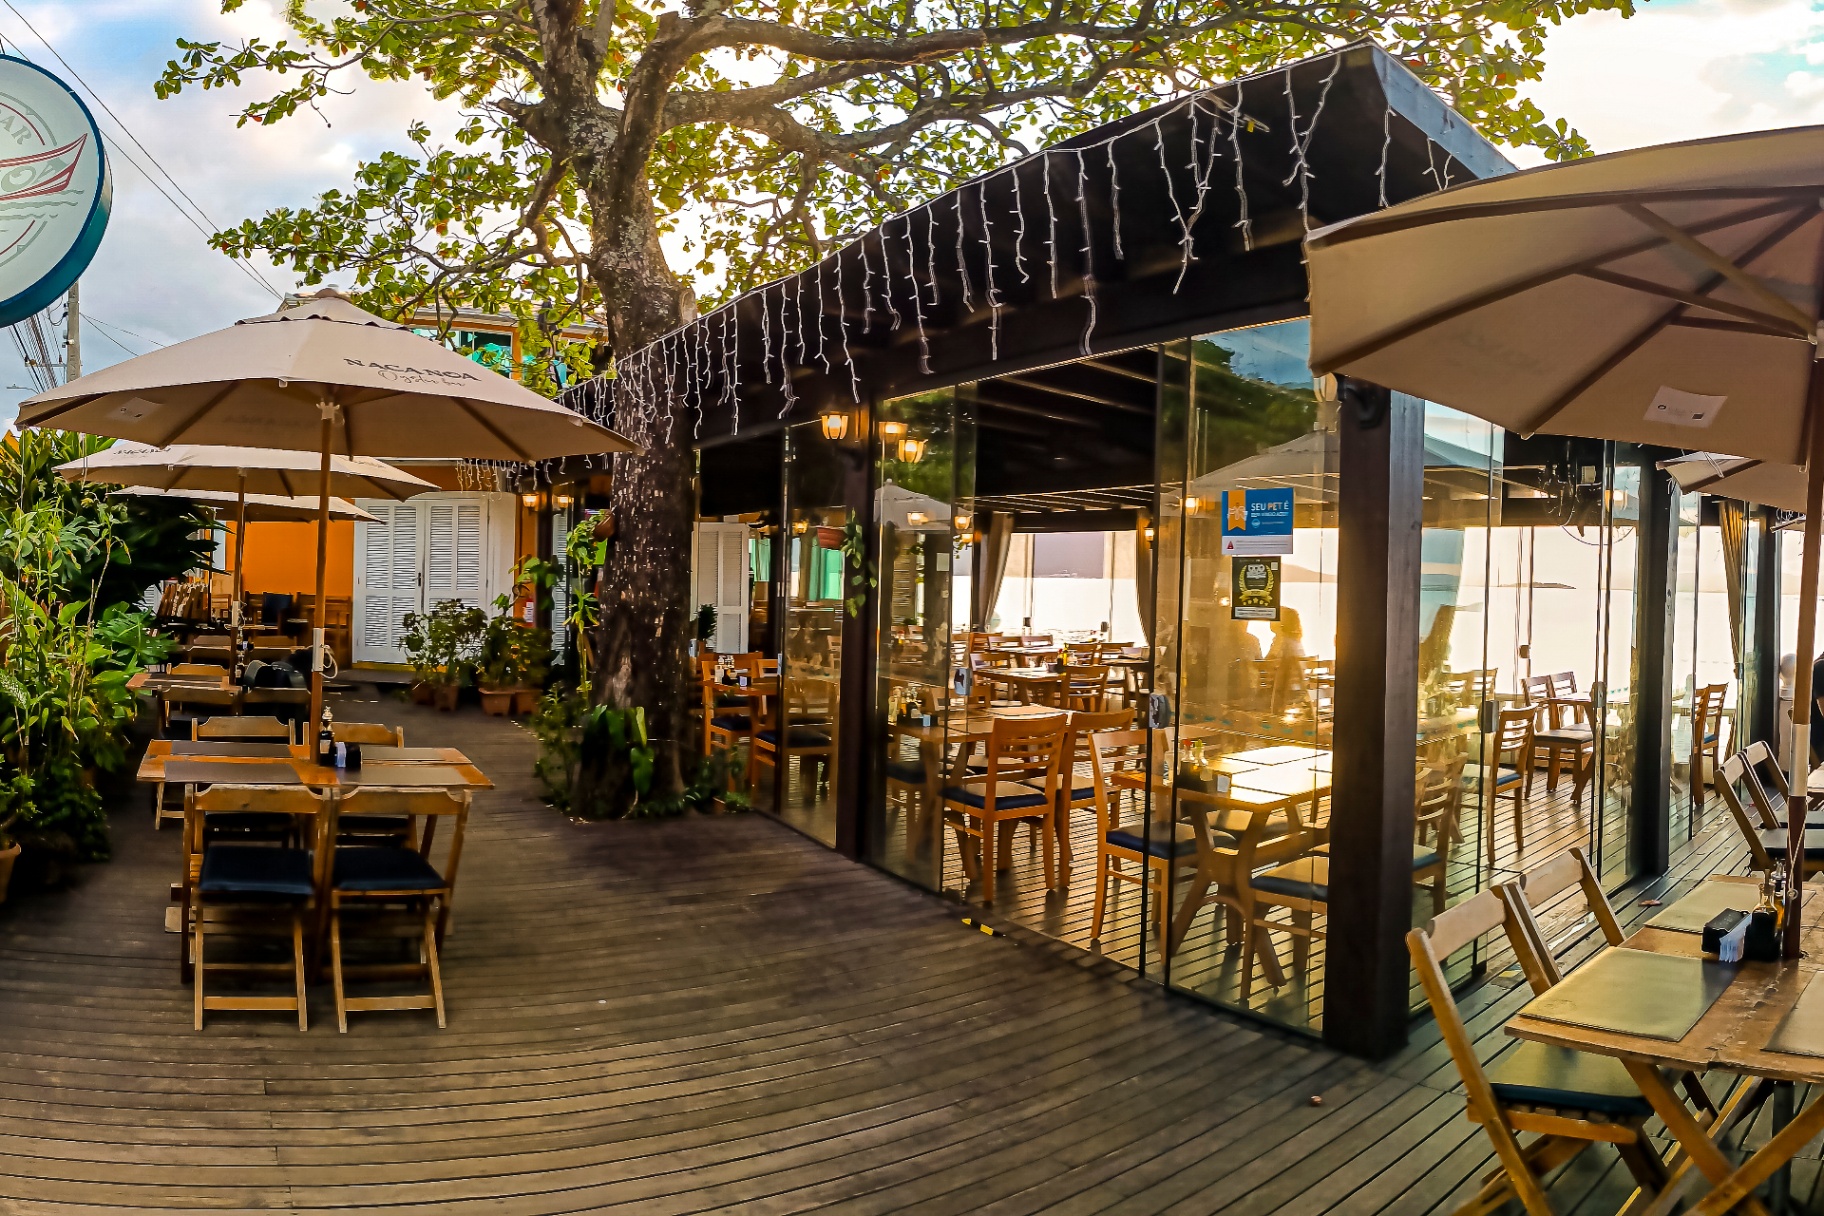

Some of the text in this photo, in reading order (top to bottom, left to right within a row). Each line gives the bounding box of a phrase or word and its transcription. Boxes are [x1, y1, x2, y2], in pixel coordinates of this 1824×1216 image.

[0, 109, 32, 145] AR
[1251, 502, 1267, 511] SEU
[1267, 501, 1283, 511] PET
